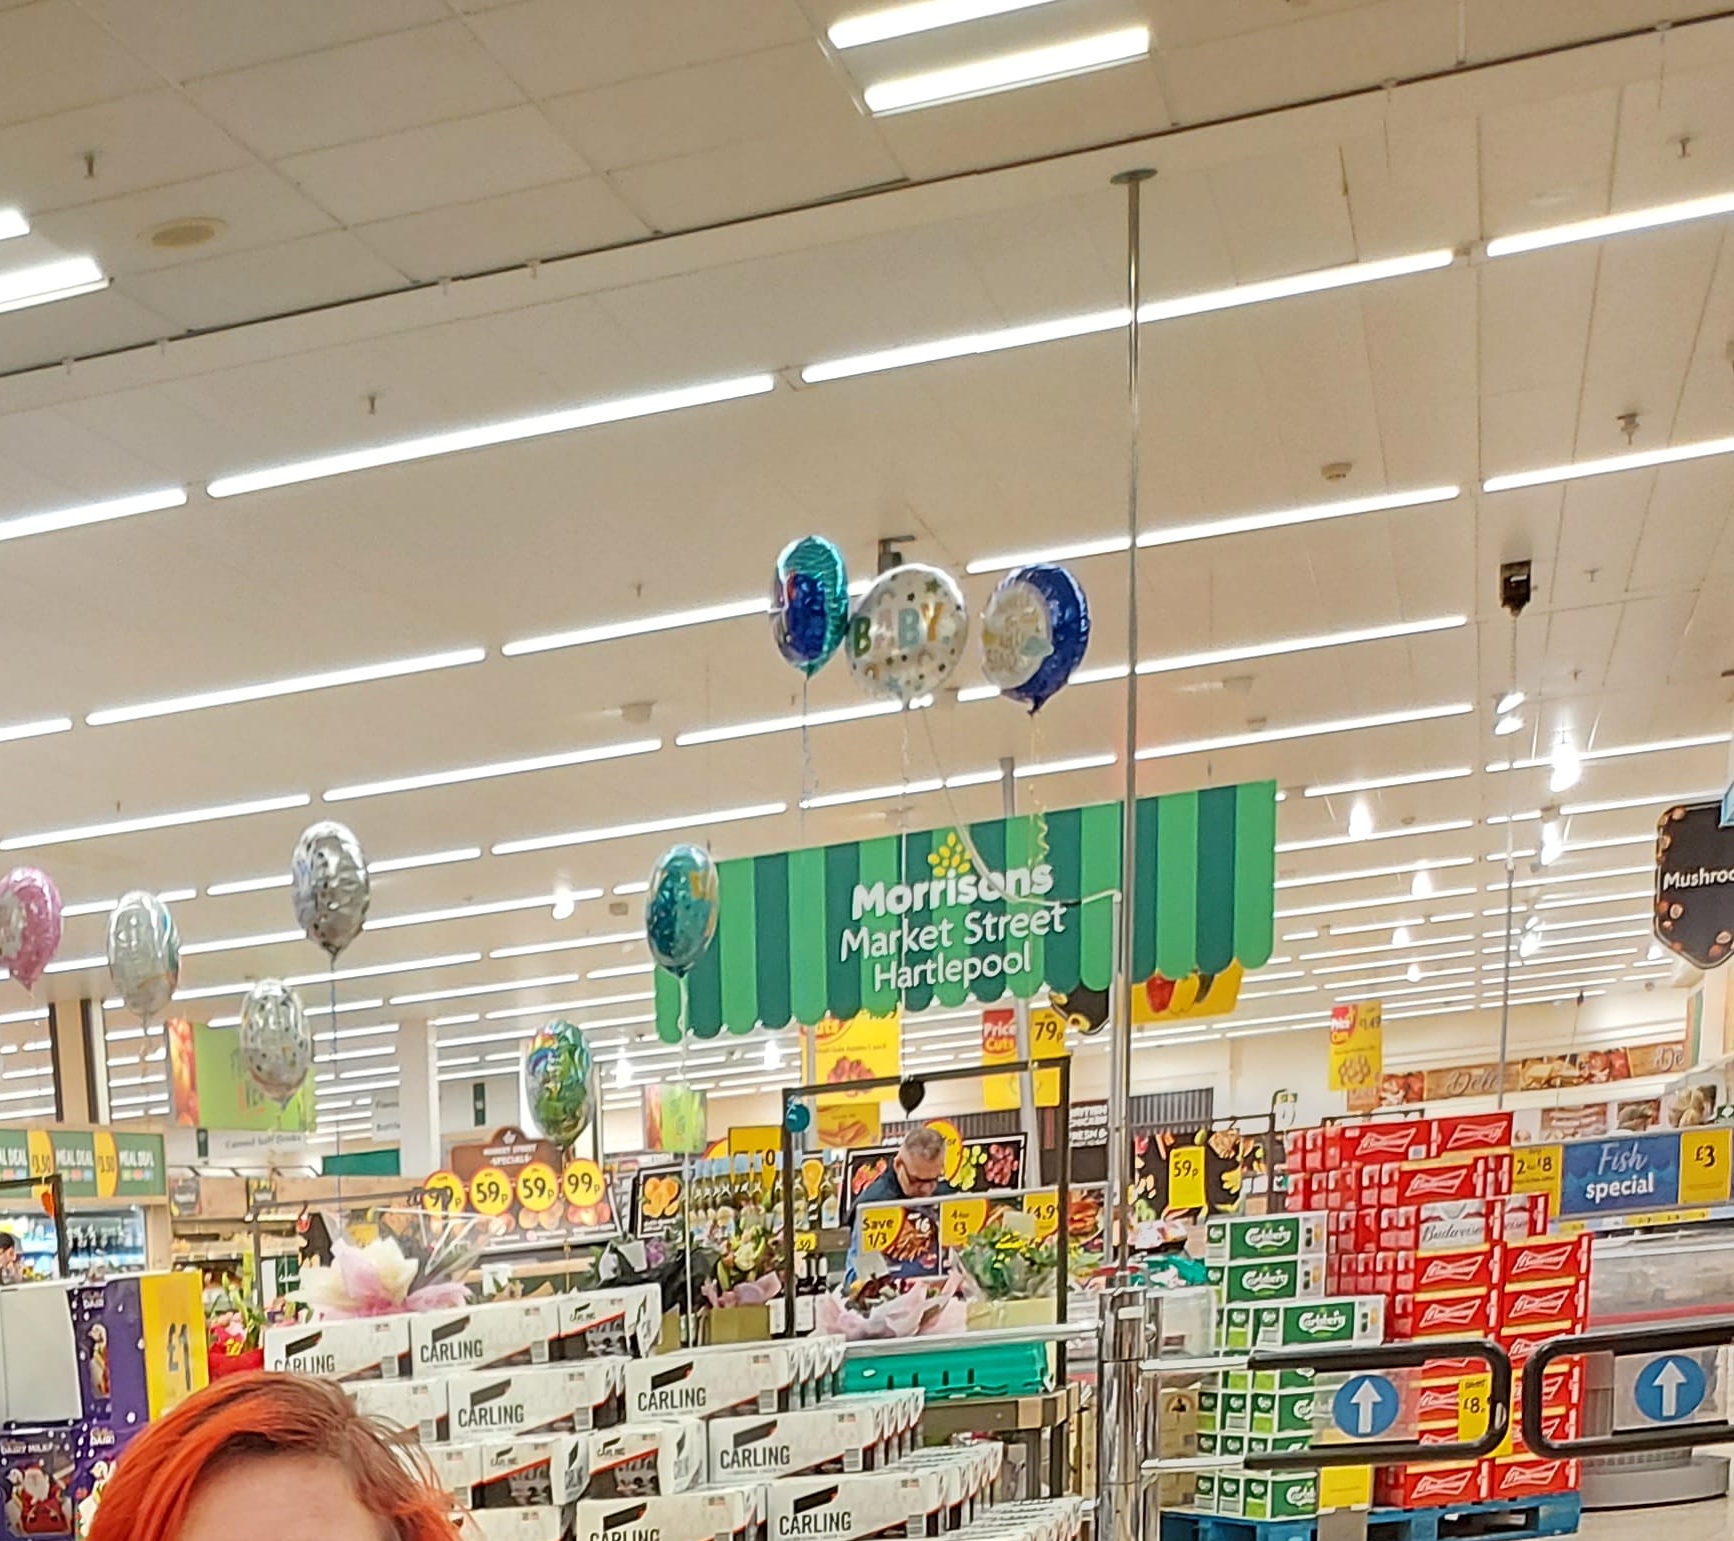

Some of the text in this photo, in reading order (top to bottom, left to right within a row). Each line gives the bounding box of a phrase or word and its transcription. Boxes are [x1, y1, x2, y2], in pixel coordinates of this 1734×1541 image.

[852, 601, 945, 657] BABY
[852, 864, 1053, 920] Morrisons
[840, 902, 1066, 962] Market Street
[874, 941, 1031, 993] Hartlepool
[984, 1021, 1015, 1037] Price
[1034, 1020, 1064, 1042] 79p
[6, 1144, 27, 1165] DEAL
[1598, 1143, 1647, 1175] Fish
[1695, 1145, 1715, 1167] £3
[1173, 1160, 1199, 1179] 59p
[475, 1181, 508, 1205] 59p
[522, 1178, 554, 1200] 59p
[568, 1173, 601, 1195] 99p
[1586, 1172, 1654, 1203] special
[862, 1215, 894, 1233] Save
[868, 1232, 888, 1246] 1/3
[1244, 1226, 1292, 1249] Carlsberg
[1298, 1310, 1347, 1333] Carlsberg
[167, 1323, 192, 1392] £1
[420, 1339, 484, 1363] CARLING
[637, 1387, 707, 1412] CARLING
[457, 1404, 525, 1428] CARLING
[719, 1445, 791, 1470] CARLING
[779, 1511, 852, 1536] CARLING
